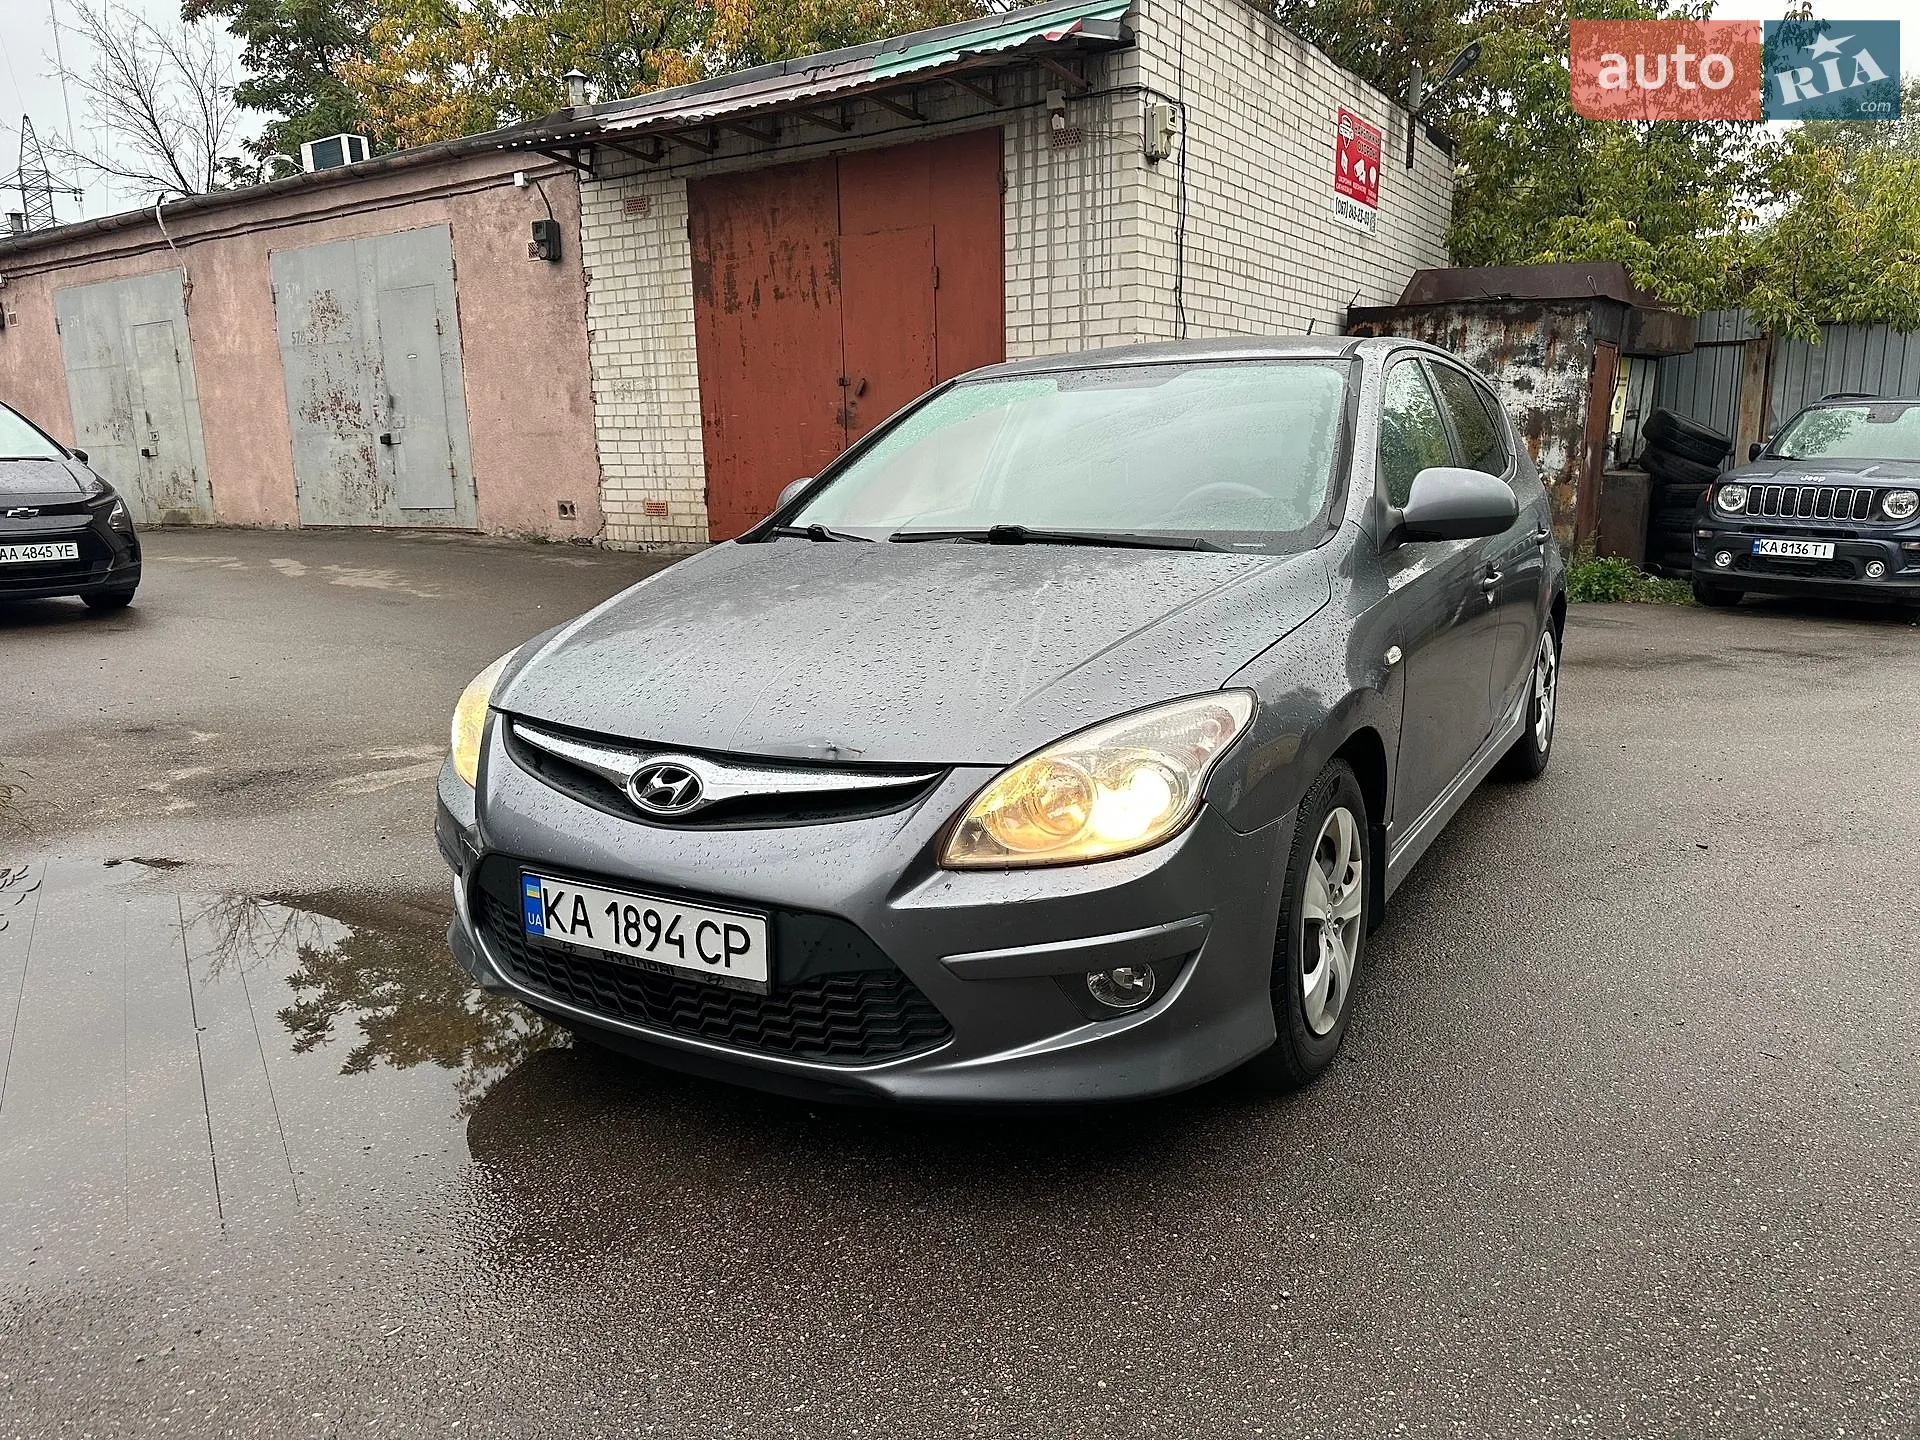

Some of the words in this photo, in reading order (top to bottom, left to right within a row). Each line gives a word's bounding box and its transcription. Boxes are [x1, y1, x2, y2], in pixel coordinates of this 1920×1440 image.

[1800, 474, 1826, 483] Jeep
[0, 547, 18, 560] AA
[22, 545, 53, 559] 4845
[56, 544, 75, 557] YE
[1760, 541, 1778, 553] KA
[1780, 542, 1809, 555] 8136
[1812, 544, 1827, 556] TI
[528, 911, 542, 928] UA
[543, 887, 593, 939] KA
[605, 901, 685, 959] 1894
[695, 919, 751, 968] CP
[602, 951, 676, 976] HYUNDAI
